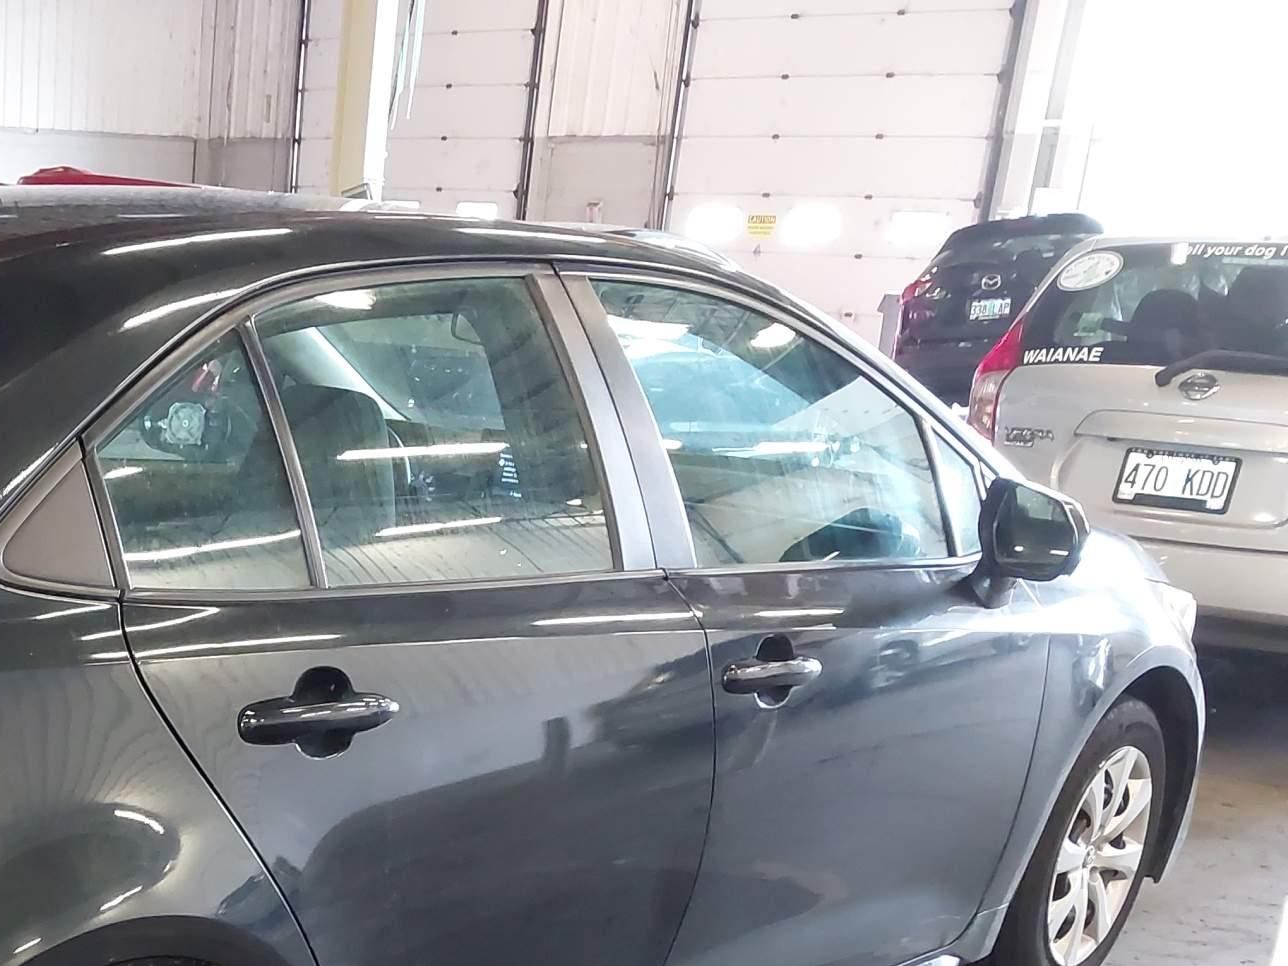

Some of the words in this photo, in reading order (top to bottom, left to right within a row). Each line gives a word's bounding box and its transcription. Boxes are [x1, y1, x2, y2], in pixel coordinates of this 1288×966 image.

[1203, 245, 1243, 258] your
[1244, 244, 1277, 260] dog
[1023, 347, 1104, 364] WAIANAE
[1124, 463, 1169, 492] 470
[1182, 469, 1229, 499] KDD
